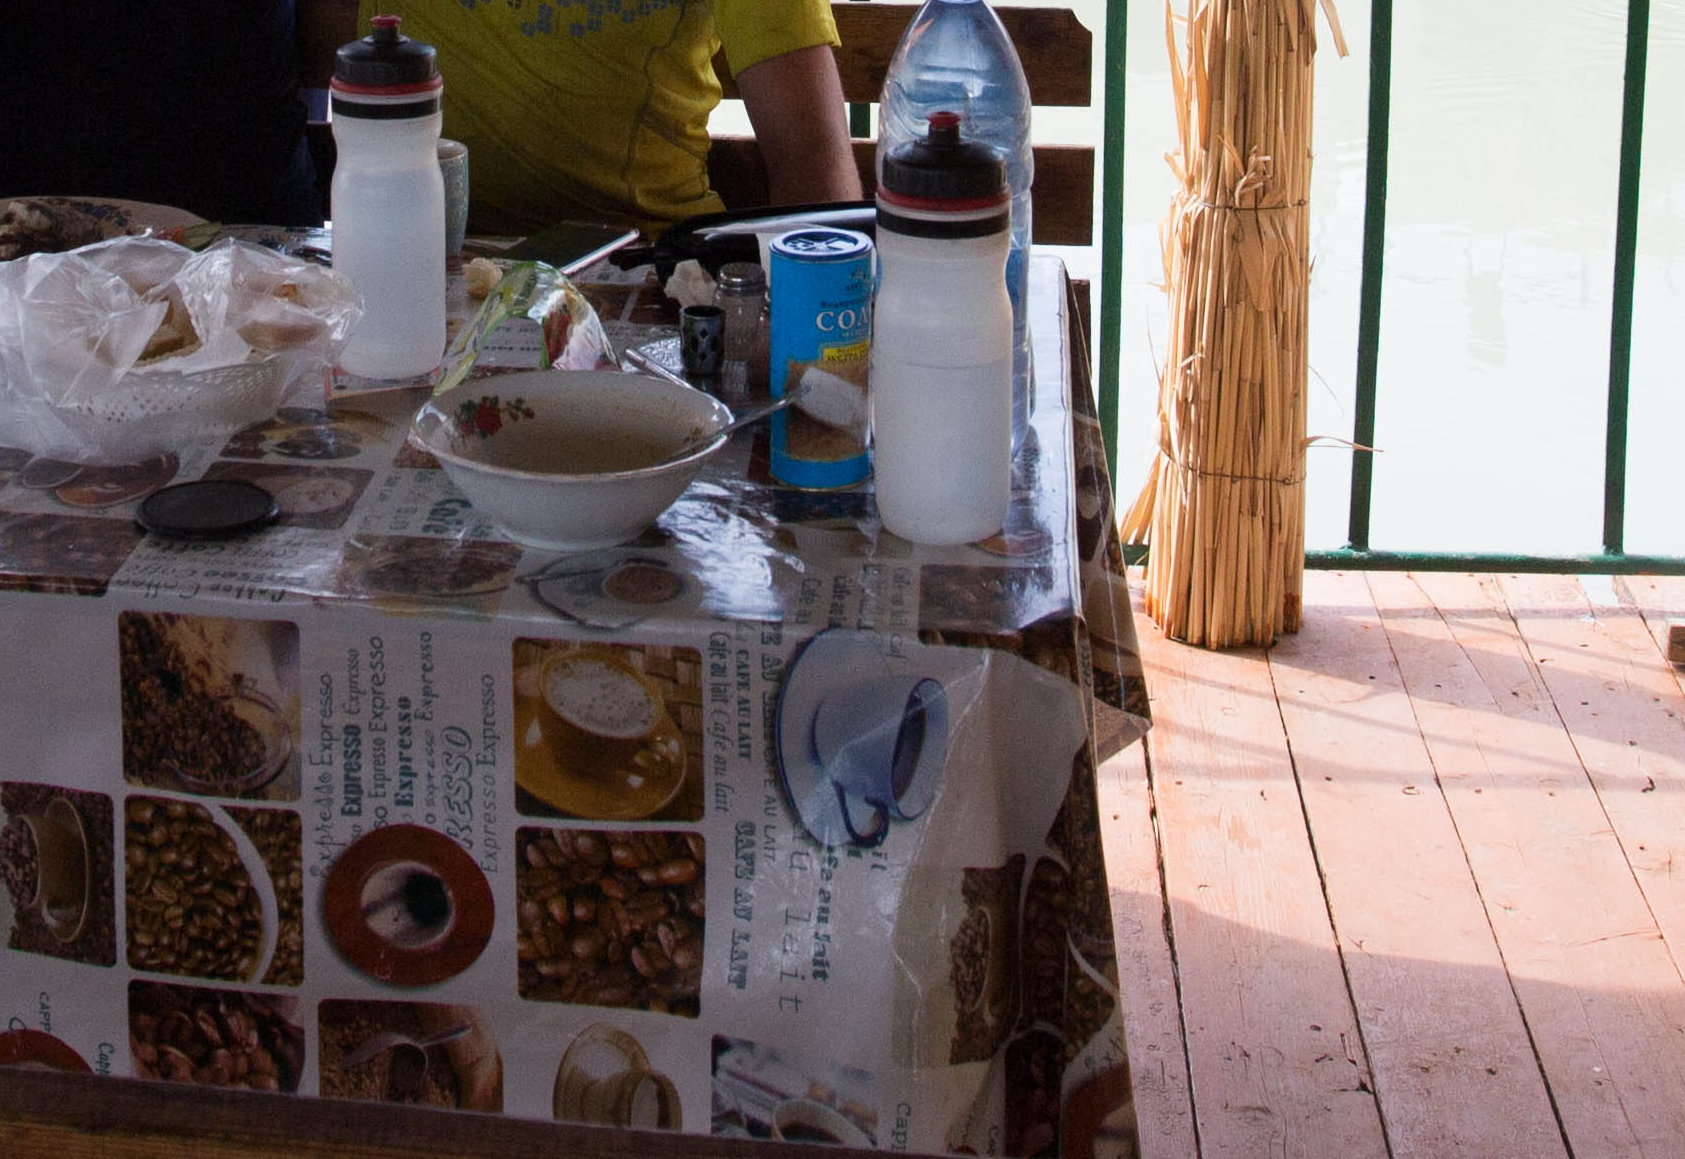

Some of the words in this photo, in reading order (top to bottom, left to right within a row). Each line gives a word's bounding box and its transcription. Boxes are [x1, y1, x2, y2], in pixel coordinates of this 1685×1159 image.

[709, 632, 733, 660] Cafe
[342, 648, 366, 715] Expresso
[368, 636, 391, 733] Expresso
[414, 631, 438, 722] Expresso
[710, 663, 730, 678] au
[711, 682, 732, 704] lait
[736, 649, 751, 692] CAFE
[309, 674, 339, 766] Expresso
[475, 674, 500, 767] Expresso
[737, 696, 751, 721] AU
[394, 696, 417, 808] Expresso
[738, 721, 752, 762] LAIT
[340, 724, 363, 818] Expresso
[368, 738, 391, 799] Expresso
[764, 794, 777, 817] AU
[762, 824, 777, 861] LAIT
[815, 889, 831, 924] au
[812, 932, 832, 982] lait
